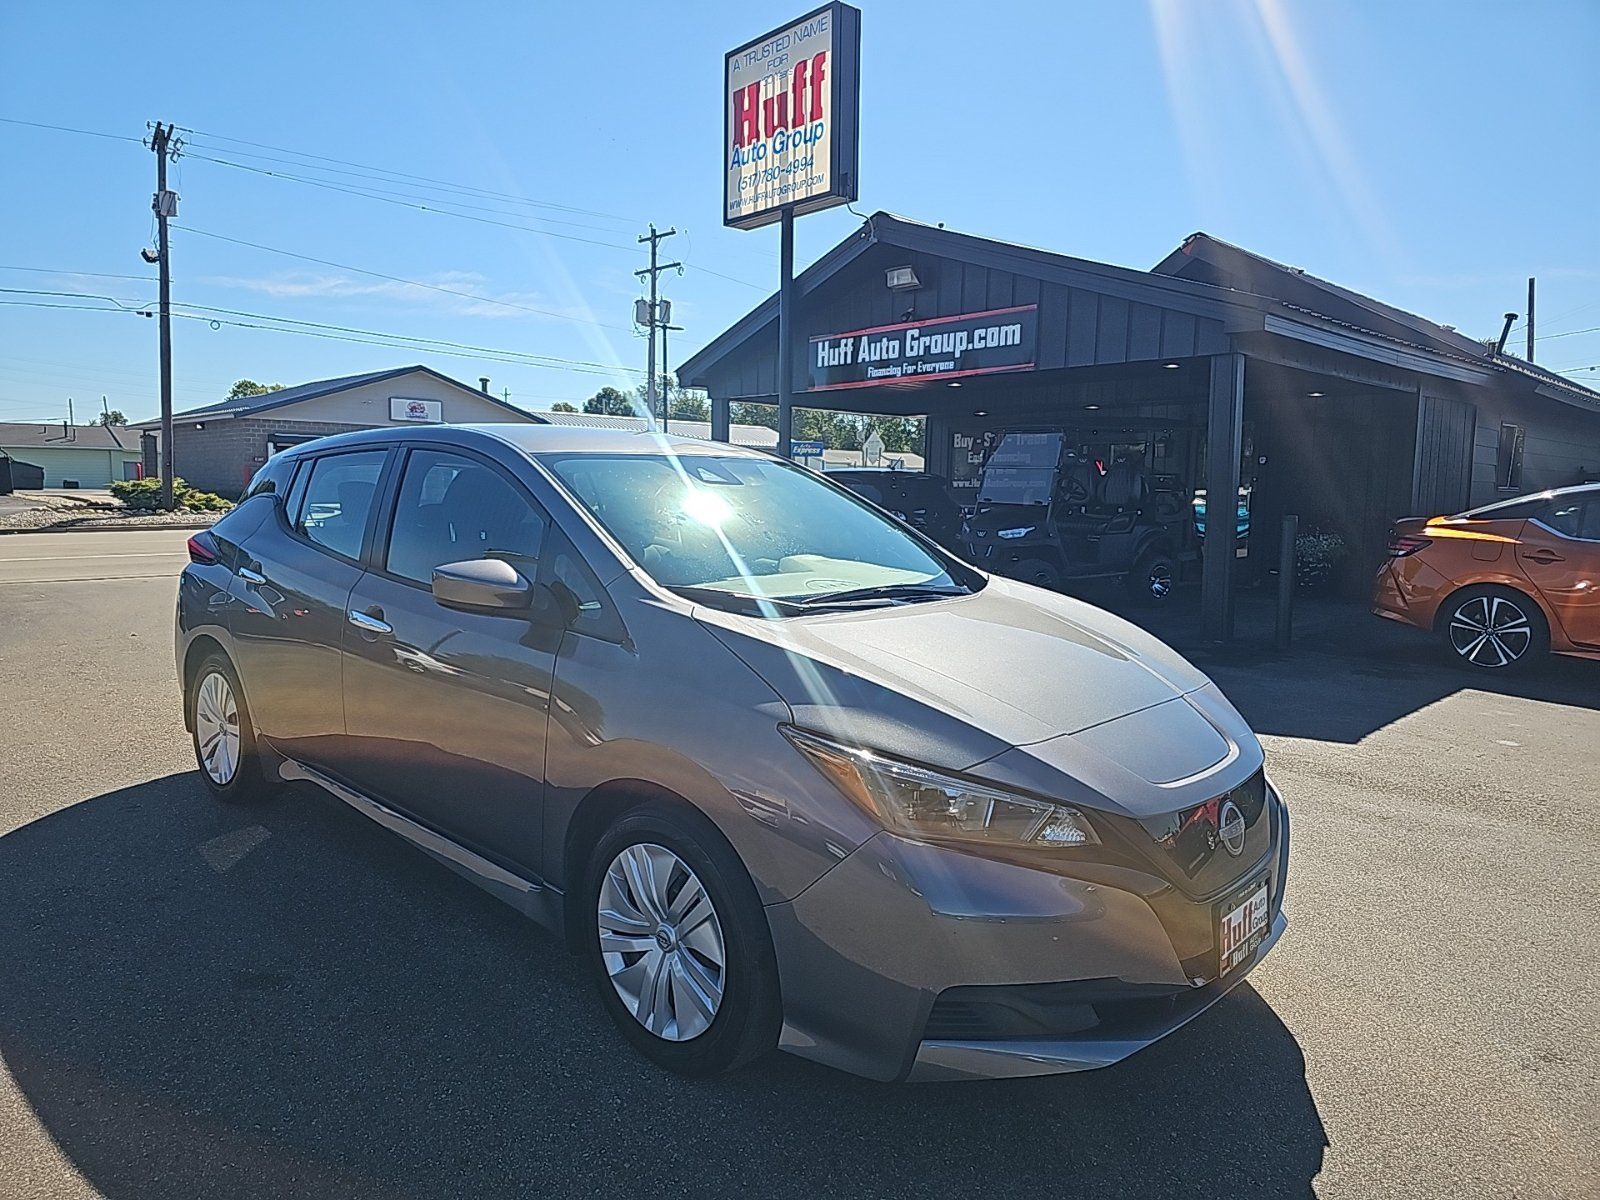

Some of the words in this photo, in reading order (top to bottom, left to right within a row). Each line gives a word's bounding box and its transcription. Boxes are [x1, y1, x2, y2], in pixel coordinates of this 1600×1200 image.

[733, 59, 741, 72] A
[743, 34, 791, 67] TRUSTED
[793, 16, 828, 45] NAME
[767, 53, 789, 71] FOR
[732, 51, 827, 149] Huff
[730, 141, 767, 170] Auto
[772, 121, 824, 154] Group
[729, 173, 825, 211] WWW.HUFFAUTOGROUP.COM
[737, 155, 815, 192] (517)780-4994
[817, 337, 854, 367] Huff
[857, 335, 900, 363] Auto
[905, 322, 1022, 358] Group.com
[867, 364, 902, 378] Financing
[902, 361, 917, 374] For
[917, 360, 955, 373] Everyone
[953, 433, 974, 450] Buy
[1221, 900, 1254, 957] Huff
